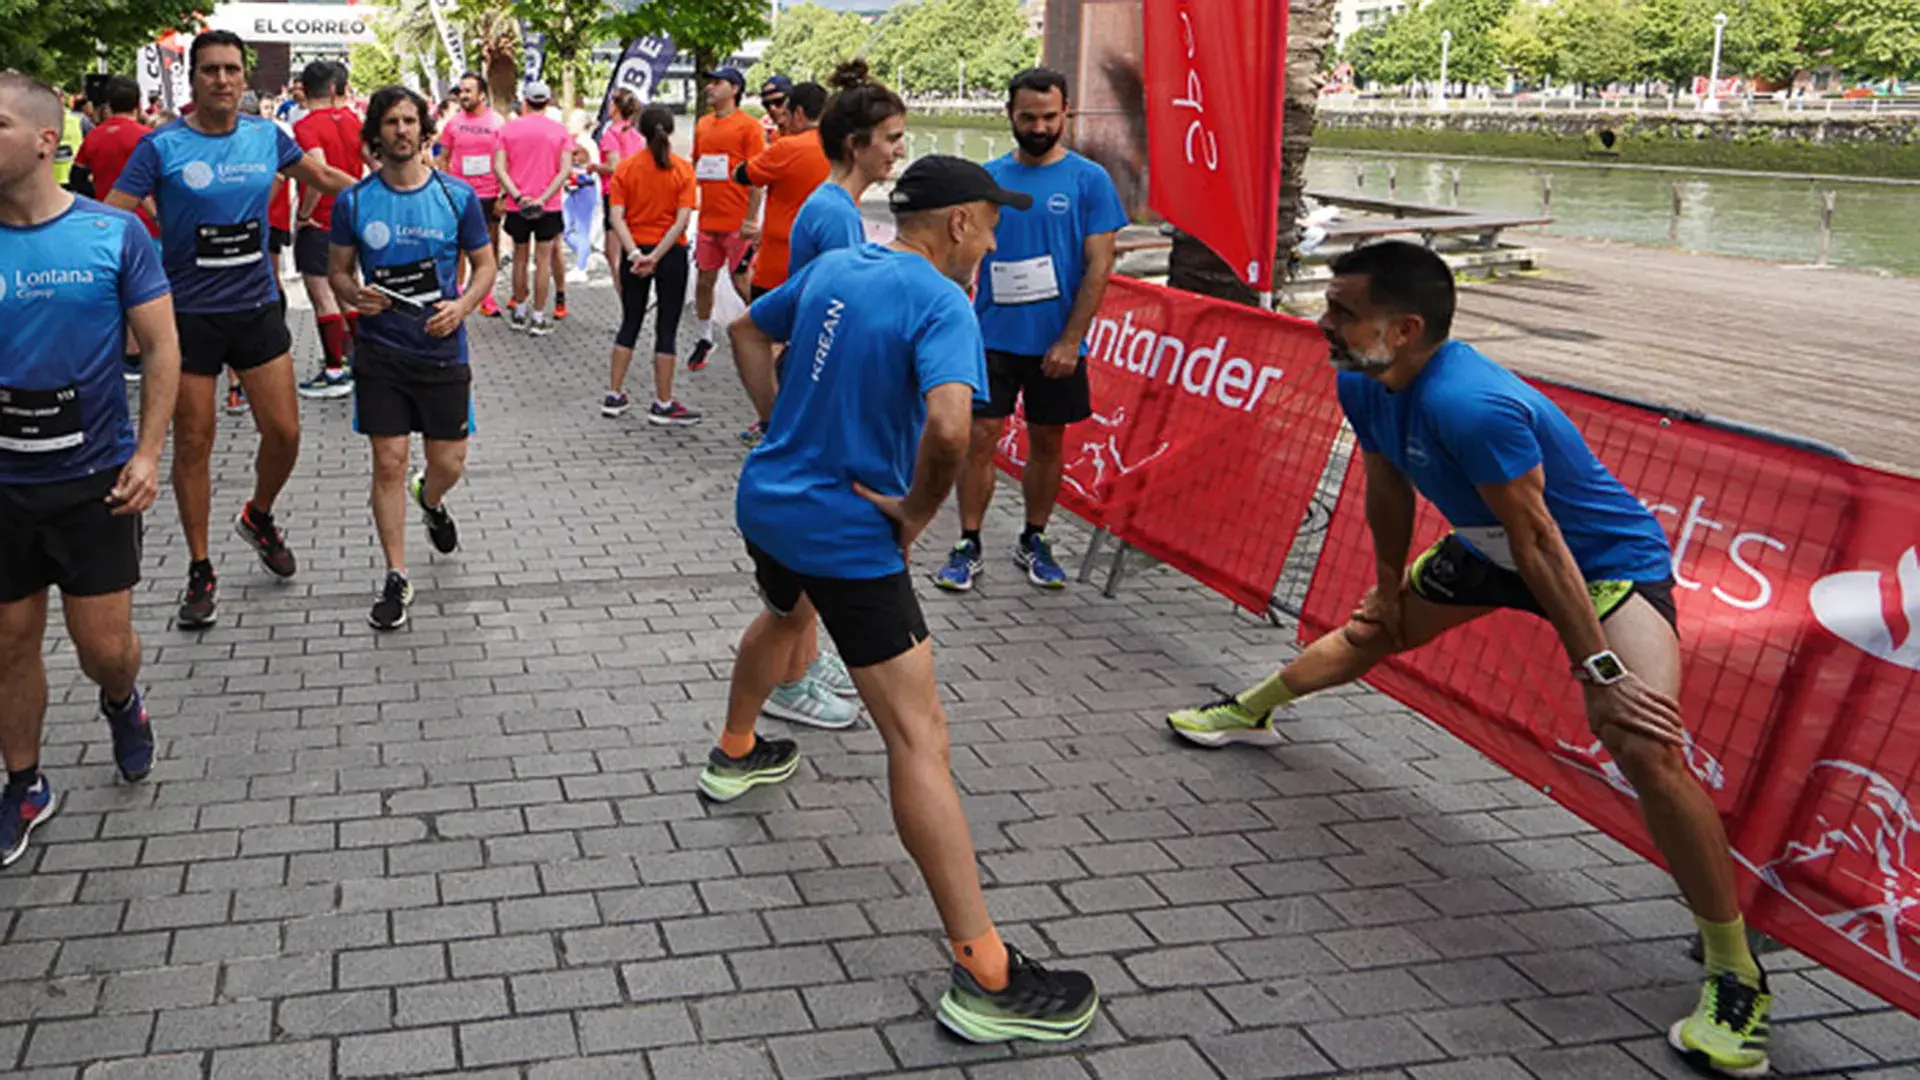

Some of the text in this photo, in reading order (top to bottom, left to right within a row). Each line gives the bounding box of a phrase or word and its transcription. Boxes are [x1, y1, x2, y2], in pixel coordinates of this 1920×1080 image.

[253, 18, 366, 35] EL CORREO
[15, 269, 95, 287] Lontana
[810, 297, 845, 383] KREAN
[1084, 310, 1285, 412] ntander
